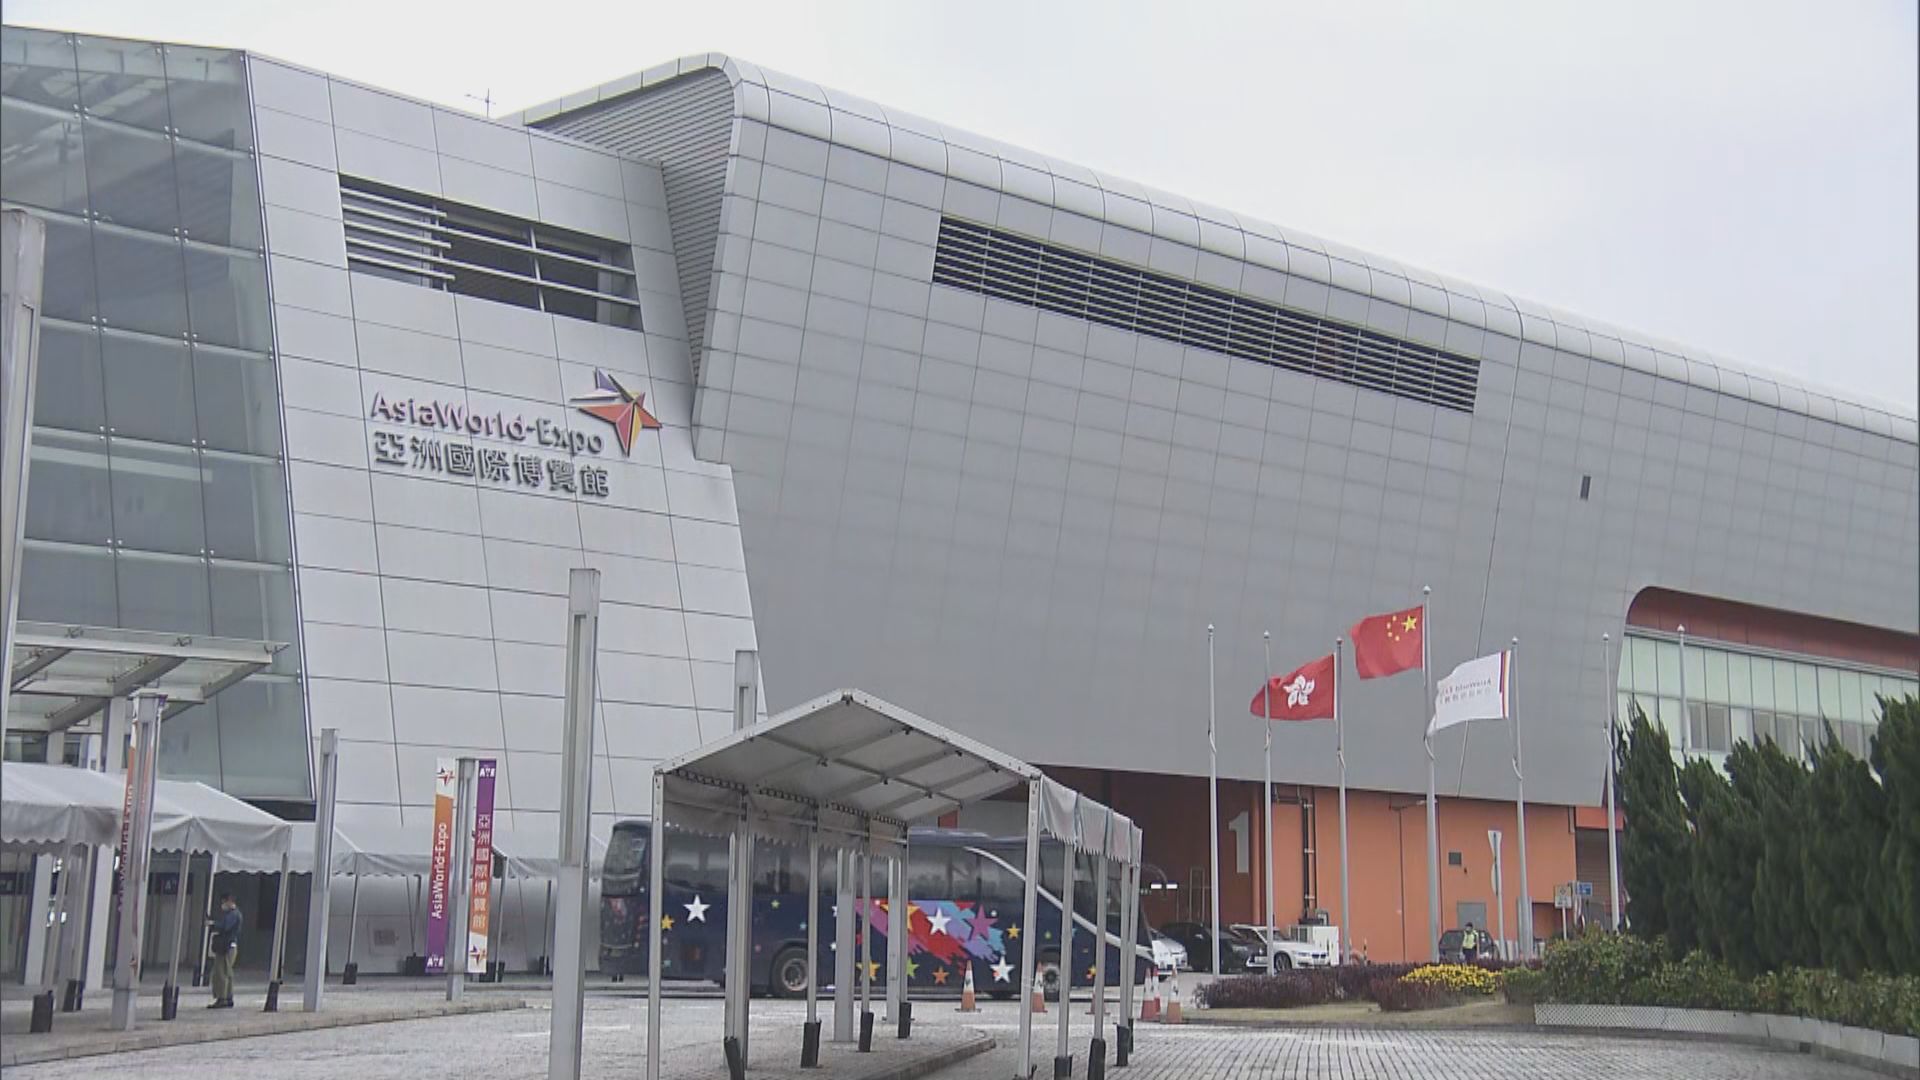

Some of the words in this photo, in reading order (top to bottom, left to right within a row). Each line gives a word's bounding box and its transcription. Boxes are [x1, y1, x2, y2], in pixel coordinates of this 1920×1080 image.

[370, 391, 605, 457] AsiaWorld-Expo
[374, 431, 610, 497] 亞洲國際博覽館
[431, 822, 448, 920] AsiaWorld-Expo
[1228, 810, 1249, 874] 1
